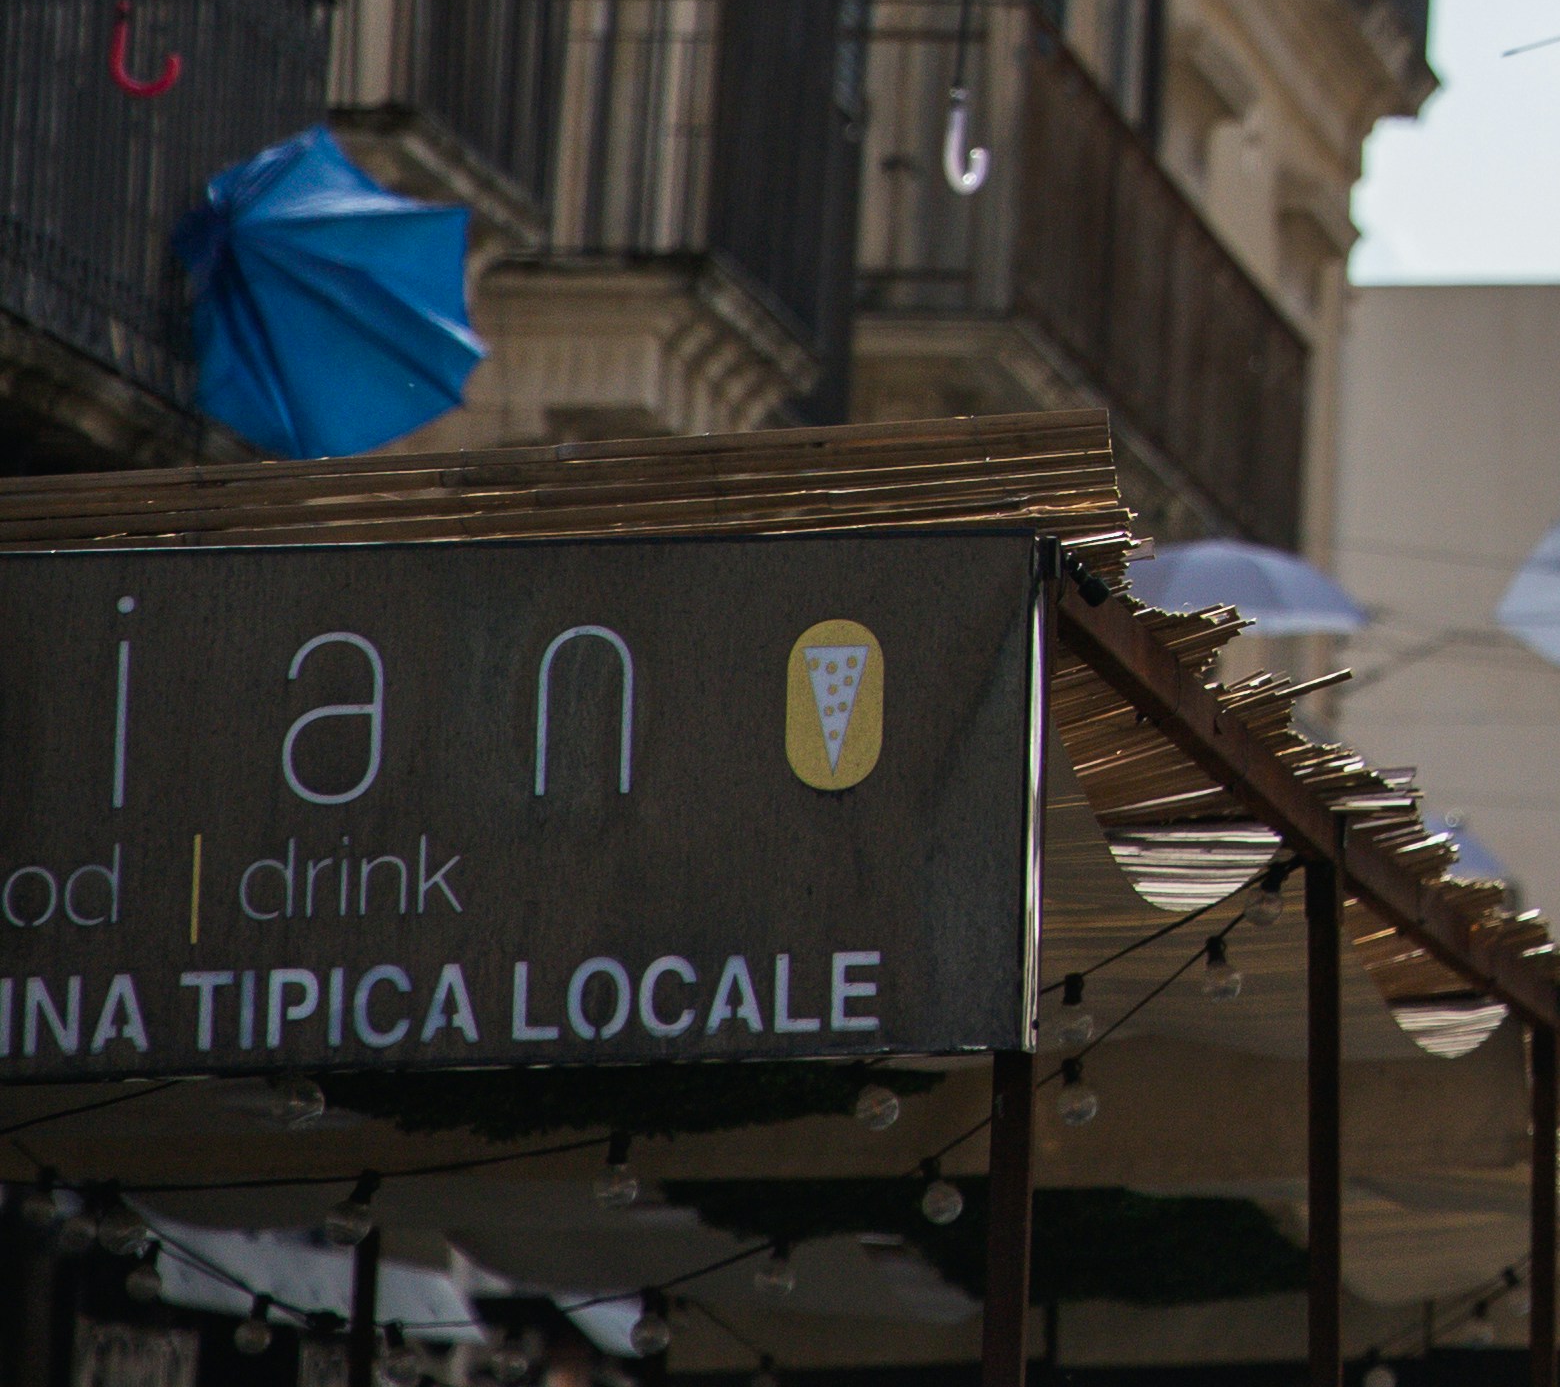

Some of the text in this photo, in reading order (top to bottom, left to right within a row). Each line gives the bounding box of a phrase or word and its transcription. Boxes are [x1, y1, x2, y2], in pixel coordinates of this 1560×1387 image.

[2, 843, 120, 927] od
[238, 833, 464, 921] drink
[180, 964, 480, 1052] TIPICA
[511, 950, 882, 1042] LOCALE
